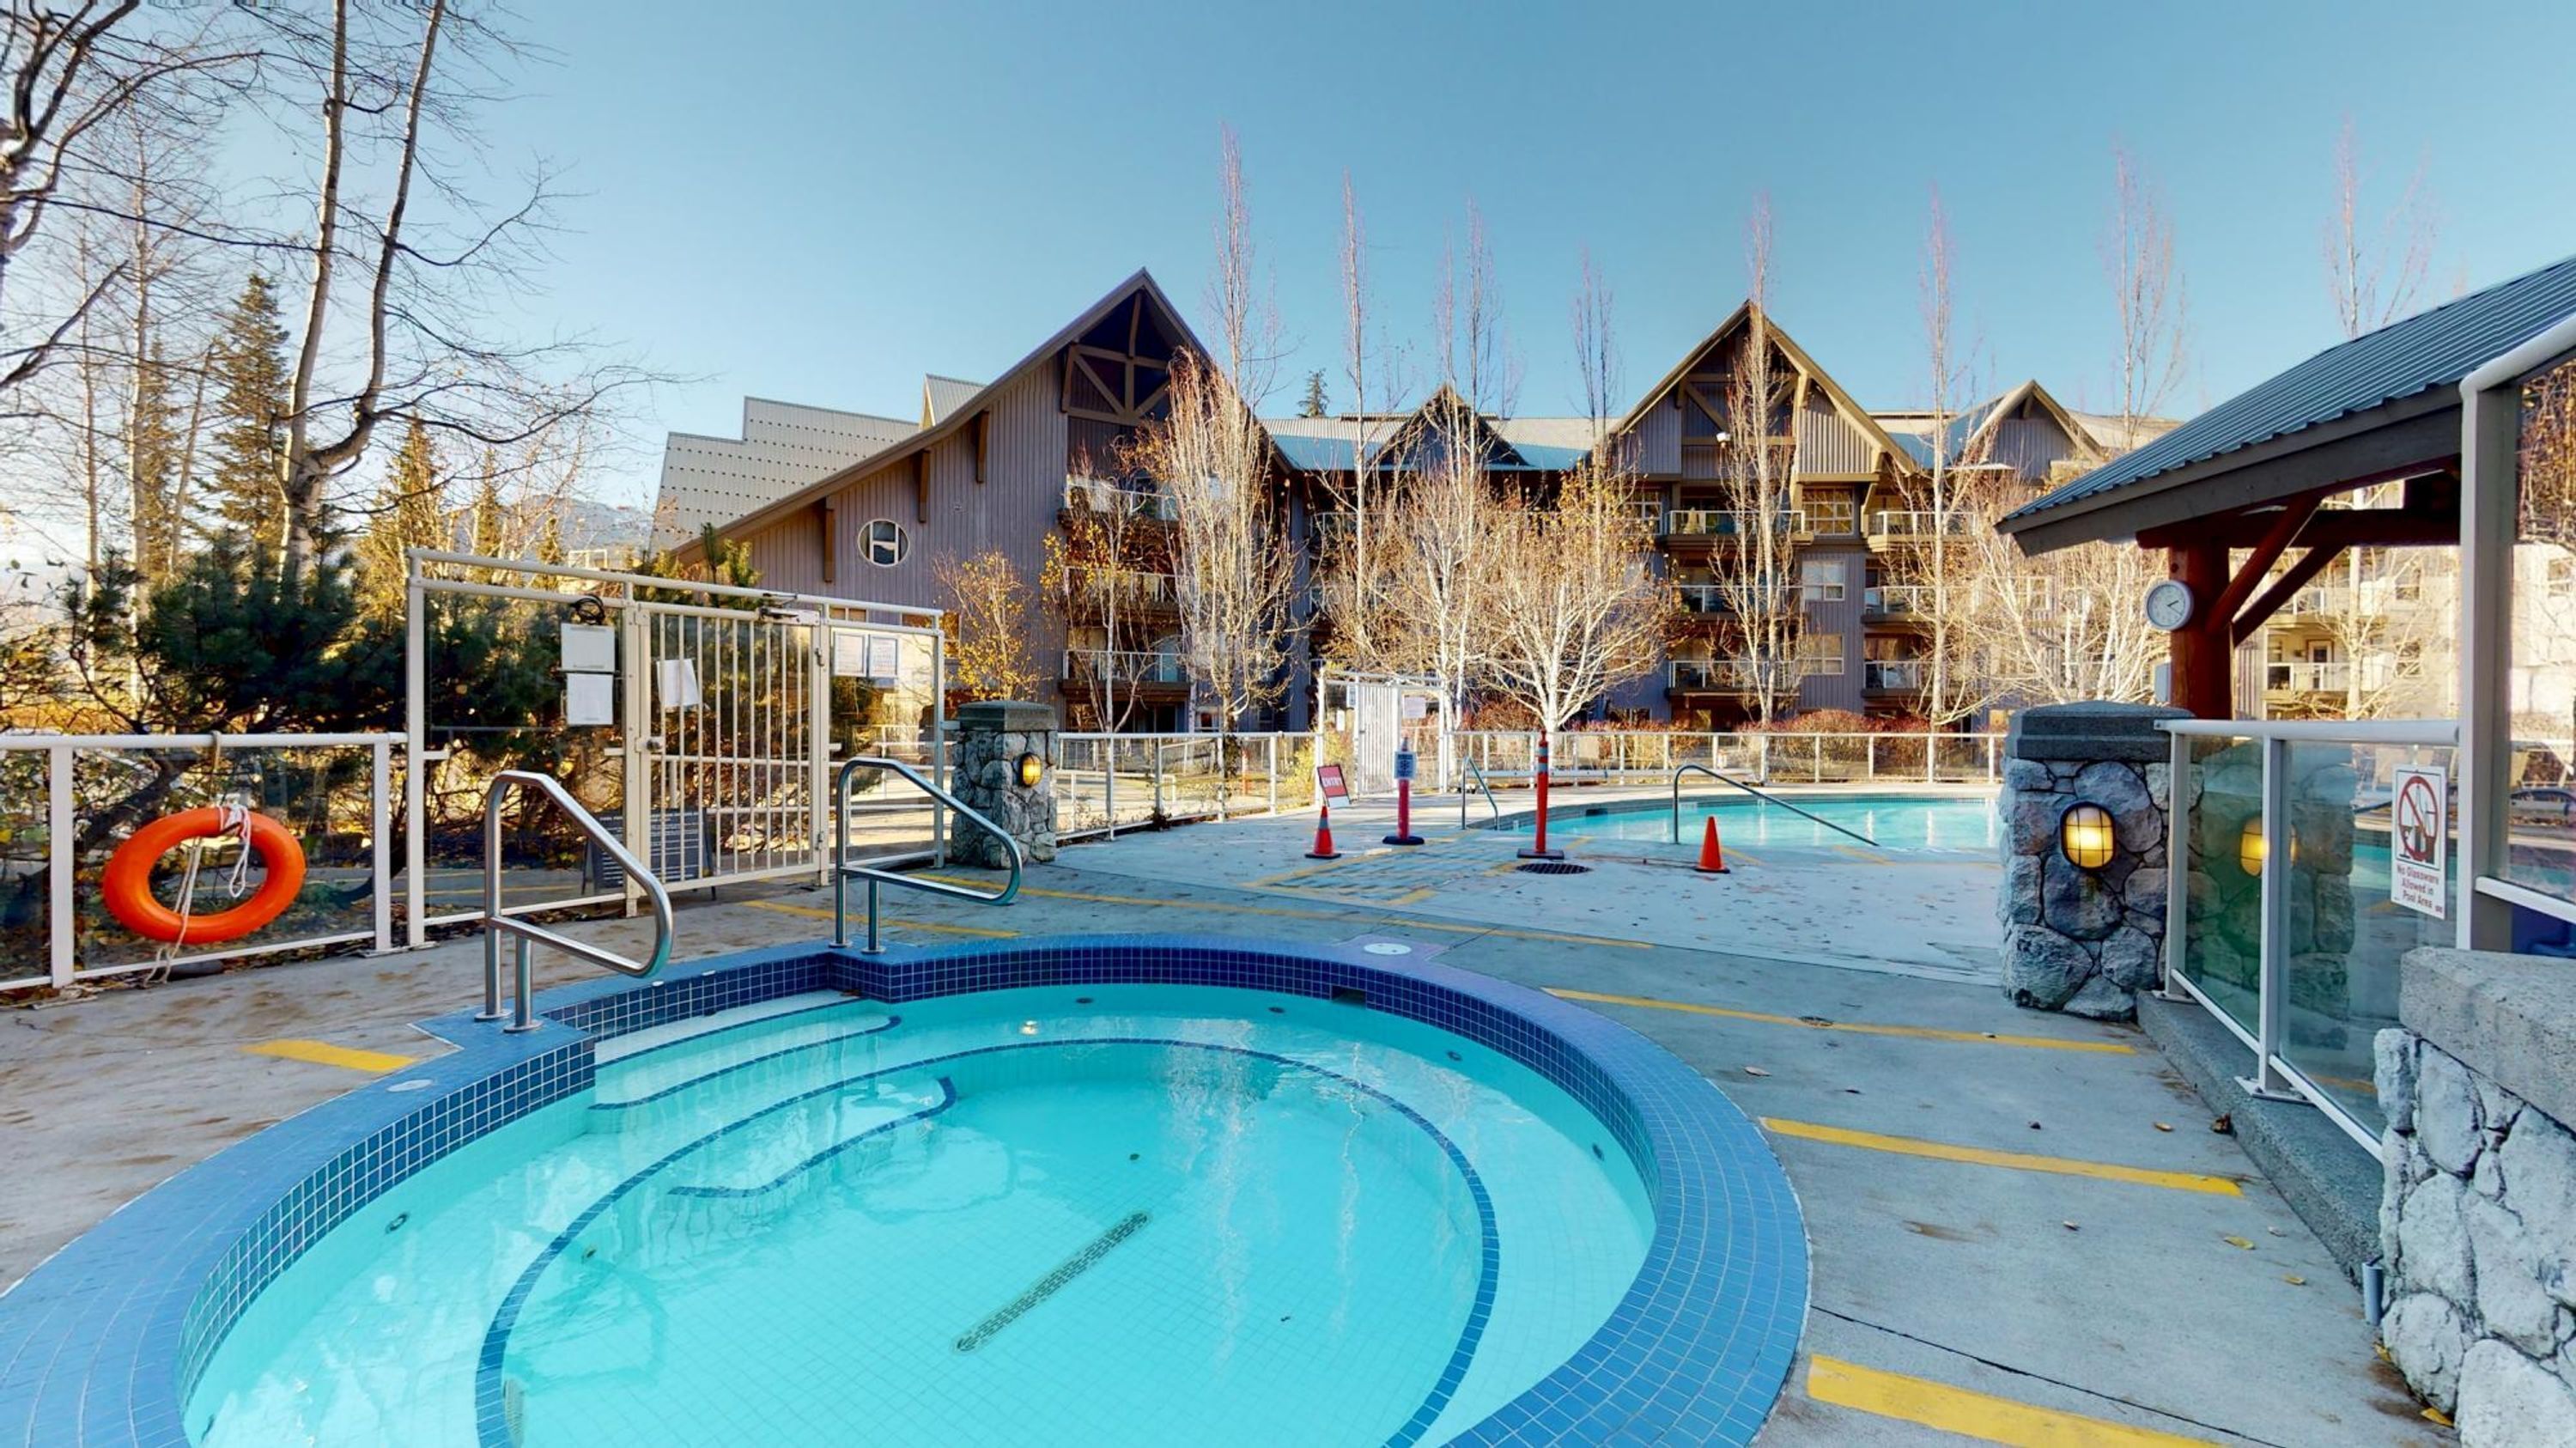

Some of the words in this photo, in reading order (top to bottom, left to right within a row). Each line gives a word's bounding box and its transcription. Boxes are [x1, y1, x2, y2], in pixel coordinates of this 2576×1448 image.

[2397, 864, 2405, 875] No
[2407, 867, 2439, 885] Glassware
[2402, 877, 2426, 894] Allowed
[2427, 887, 2434, 896] in
[2403, 889, 2415, 903] Pool
[2418, 895, 2432, 909] Area
